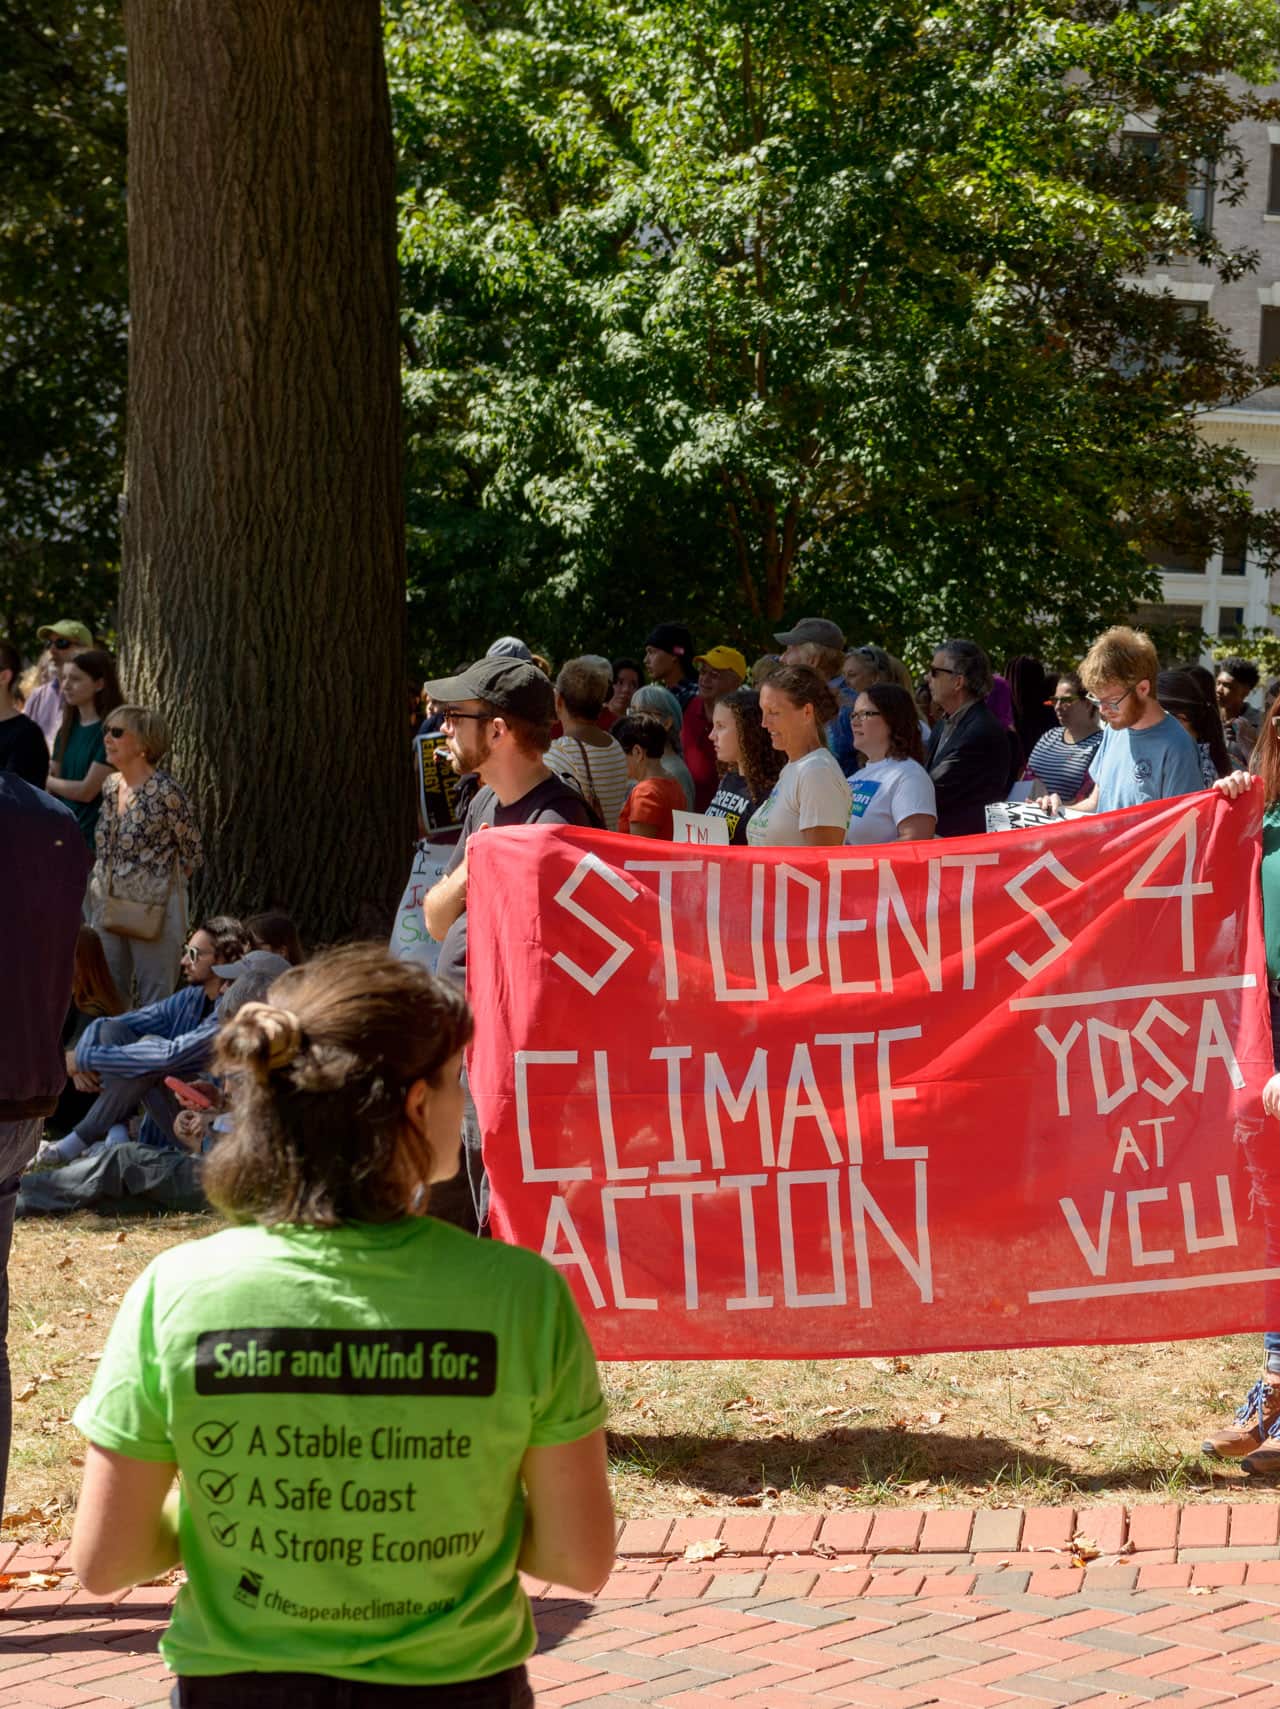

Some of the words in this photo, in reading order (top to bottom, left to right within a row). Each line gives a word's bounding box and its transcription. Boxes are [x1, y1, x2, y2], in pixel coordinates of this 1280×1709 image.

[421, 739, 441, 794] ENERGY
[552, 850, 1083, 1002] STUDENTS
[1123, 806, 1213, 972] 4
[1034, 998, 1246, 1117] YDSA
[514, 1025, 930, 1184] CLIMATE
[1112, 1115, 1175, 1175] AT
[540, 1160, 934, 1310] ACTION
[1059, 1174, 1239, 1276] VCU
[213, 1341, 284, 1380] Solar
[291, 1342, 341, 1379] and
[348, 1342, 424, 1379] Wind
[429, 1342, 480, 1380] for:
[247, 1425, 267, 1457] A
[275, 1424, 362, 1459] Stable
[371, 1426, 472, 1461] Climate
[247, 1476, 267, 1508] A
[275, 1478, 333, 1512] Safe
[340, 1480, 418, 1513] Coast
[249, 1526, 267, 1555] A
[274, 1529, 364, 1567] Strong
[371, 1529, 485, 1563] Economy
